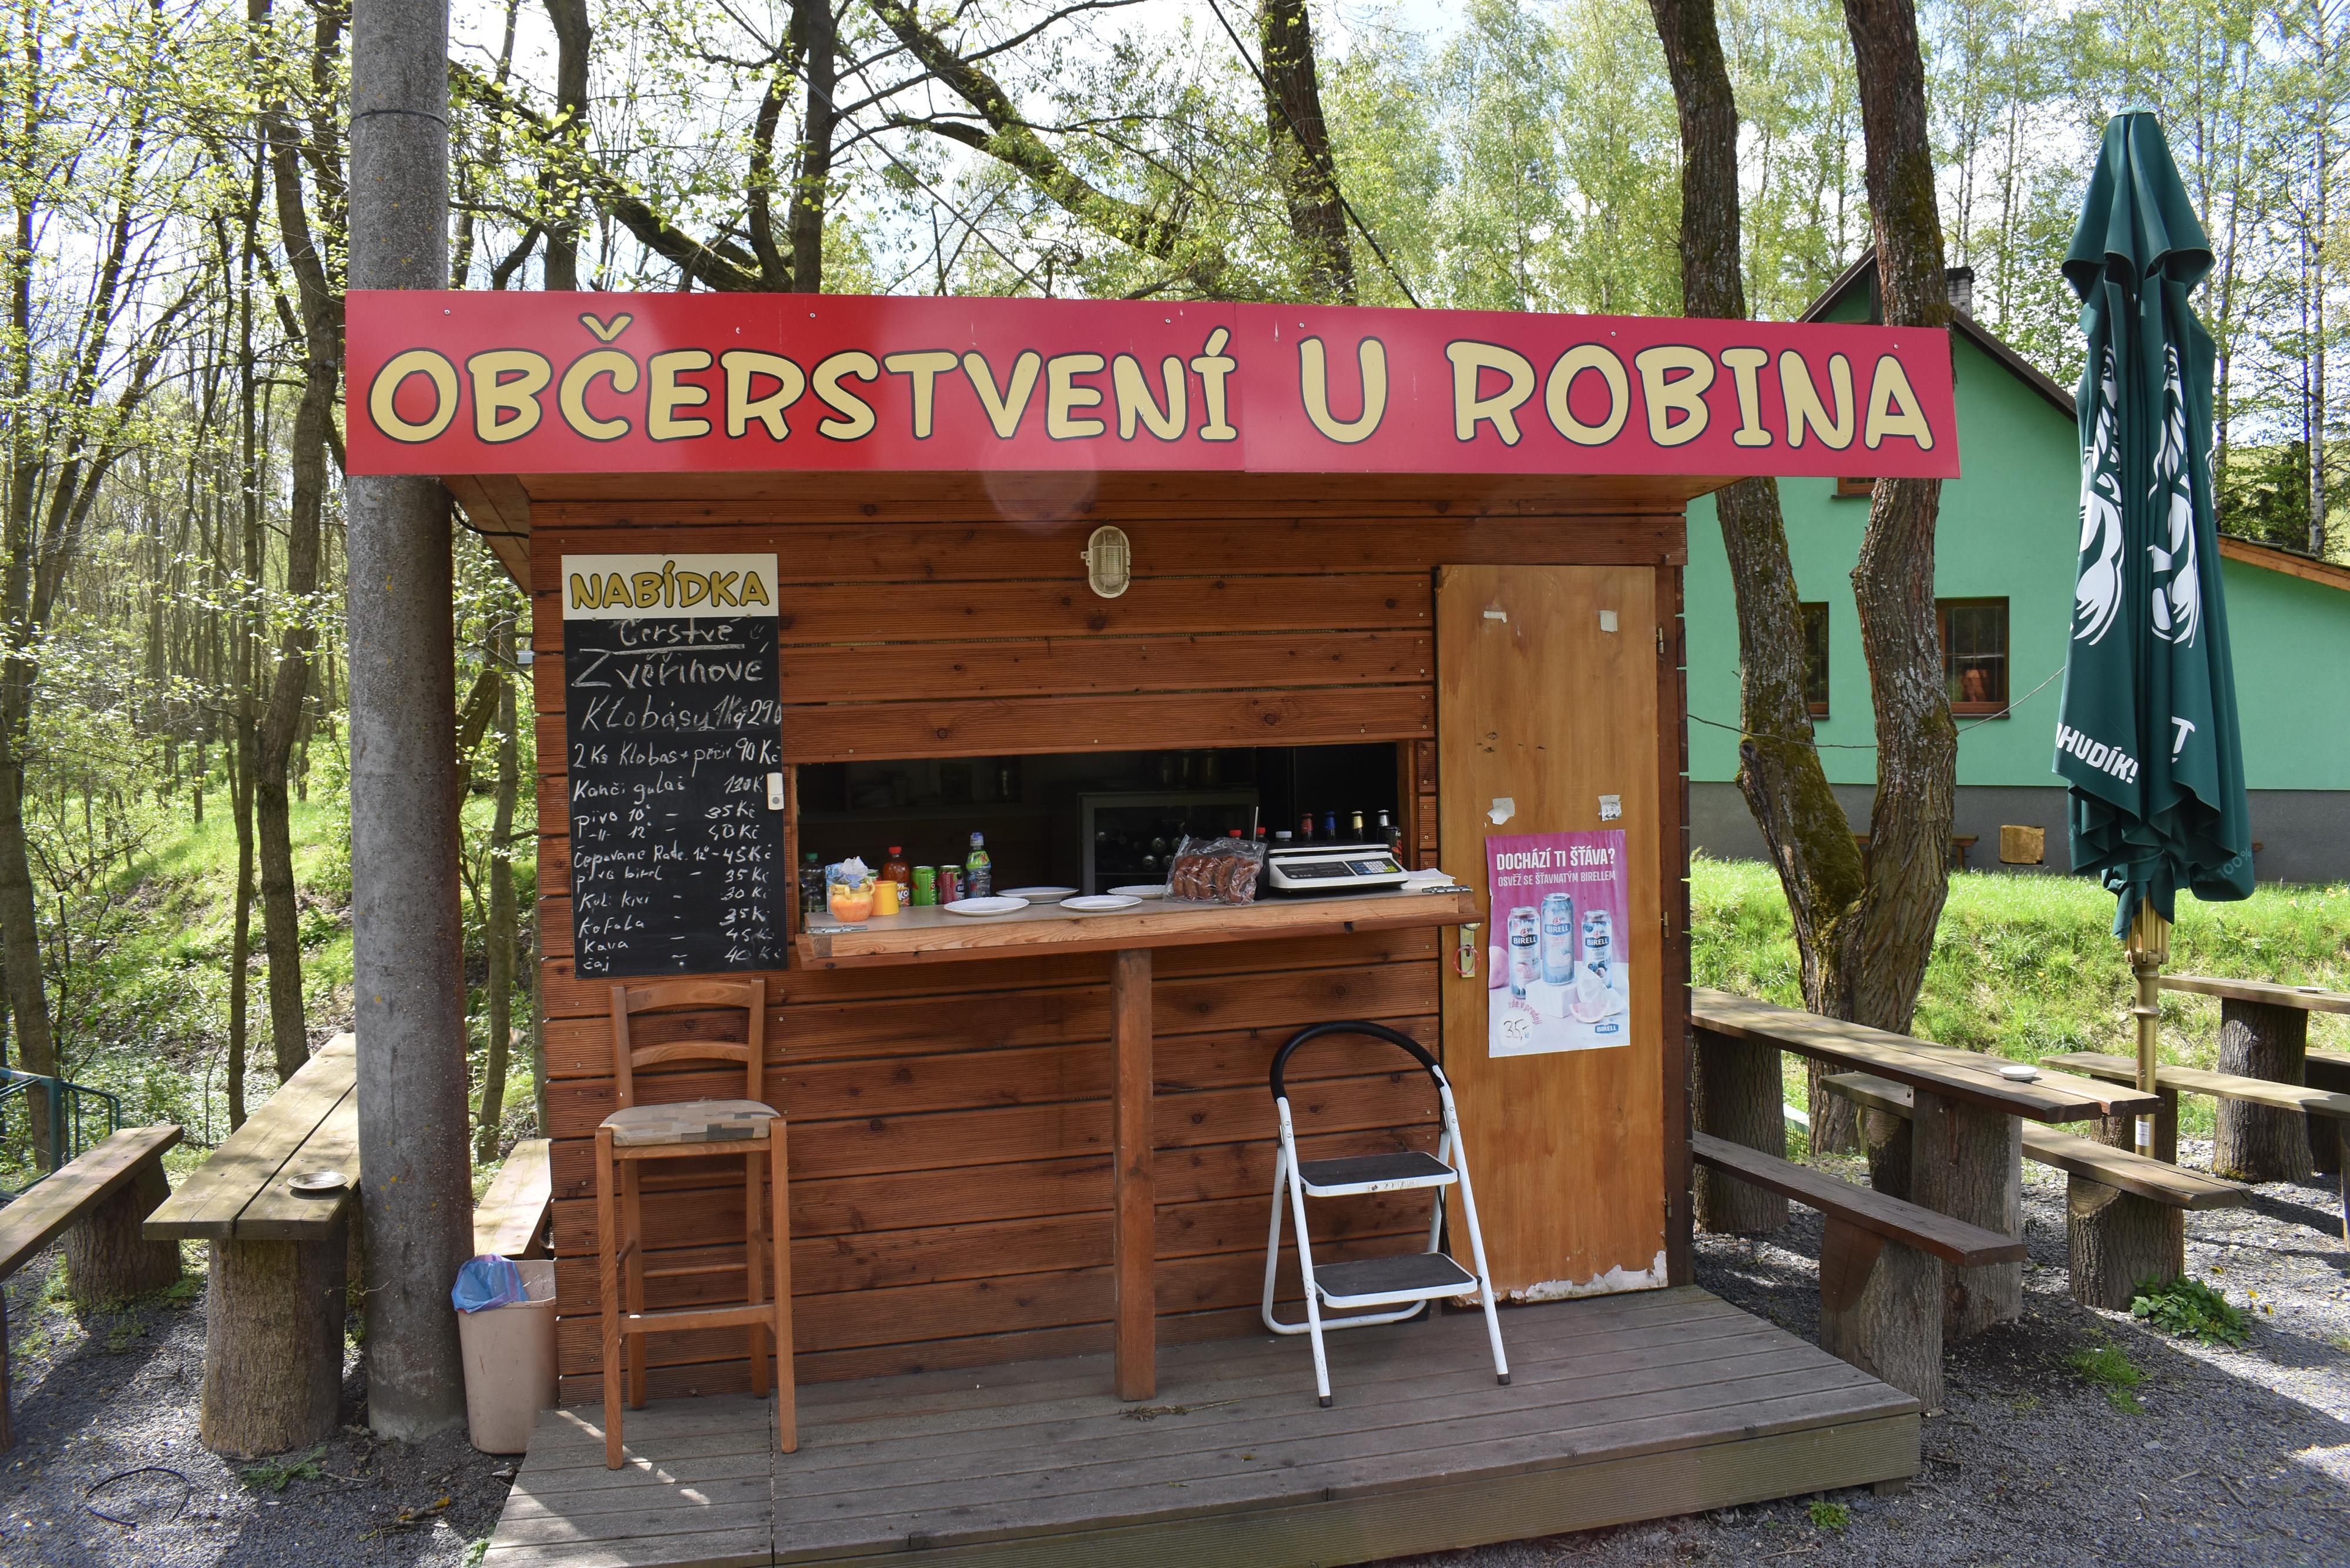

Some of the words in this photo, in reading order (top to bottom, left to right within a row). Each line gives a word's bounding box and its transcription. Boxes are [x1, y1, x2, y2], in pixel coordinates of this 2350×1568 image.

[367, 311, 1238, 444] OBČERSTVENÍ
[1297, 334, 1390, 446] U
[1446, 340, 1934, 452] ROBINA
[570, 560, 770, 610] NABÍDKA
[1496, 847, 1551, 871] DOCHÁZÍ
[1554, 851, 1566, 867] TI
[1570, 845, 1615, 867] ŠŤÁVA?
[1498, 873, 1521, 887] OSVĚŽ
[1524, 875, 1533, 885] SE
[1536, 871, 1578, 884] ŠŤAVNATÝM
[1581, 871, 1616, 882] BIRELLEM
[1596, 1023, 1617, 1032] BIRELL
